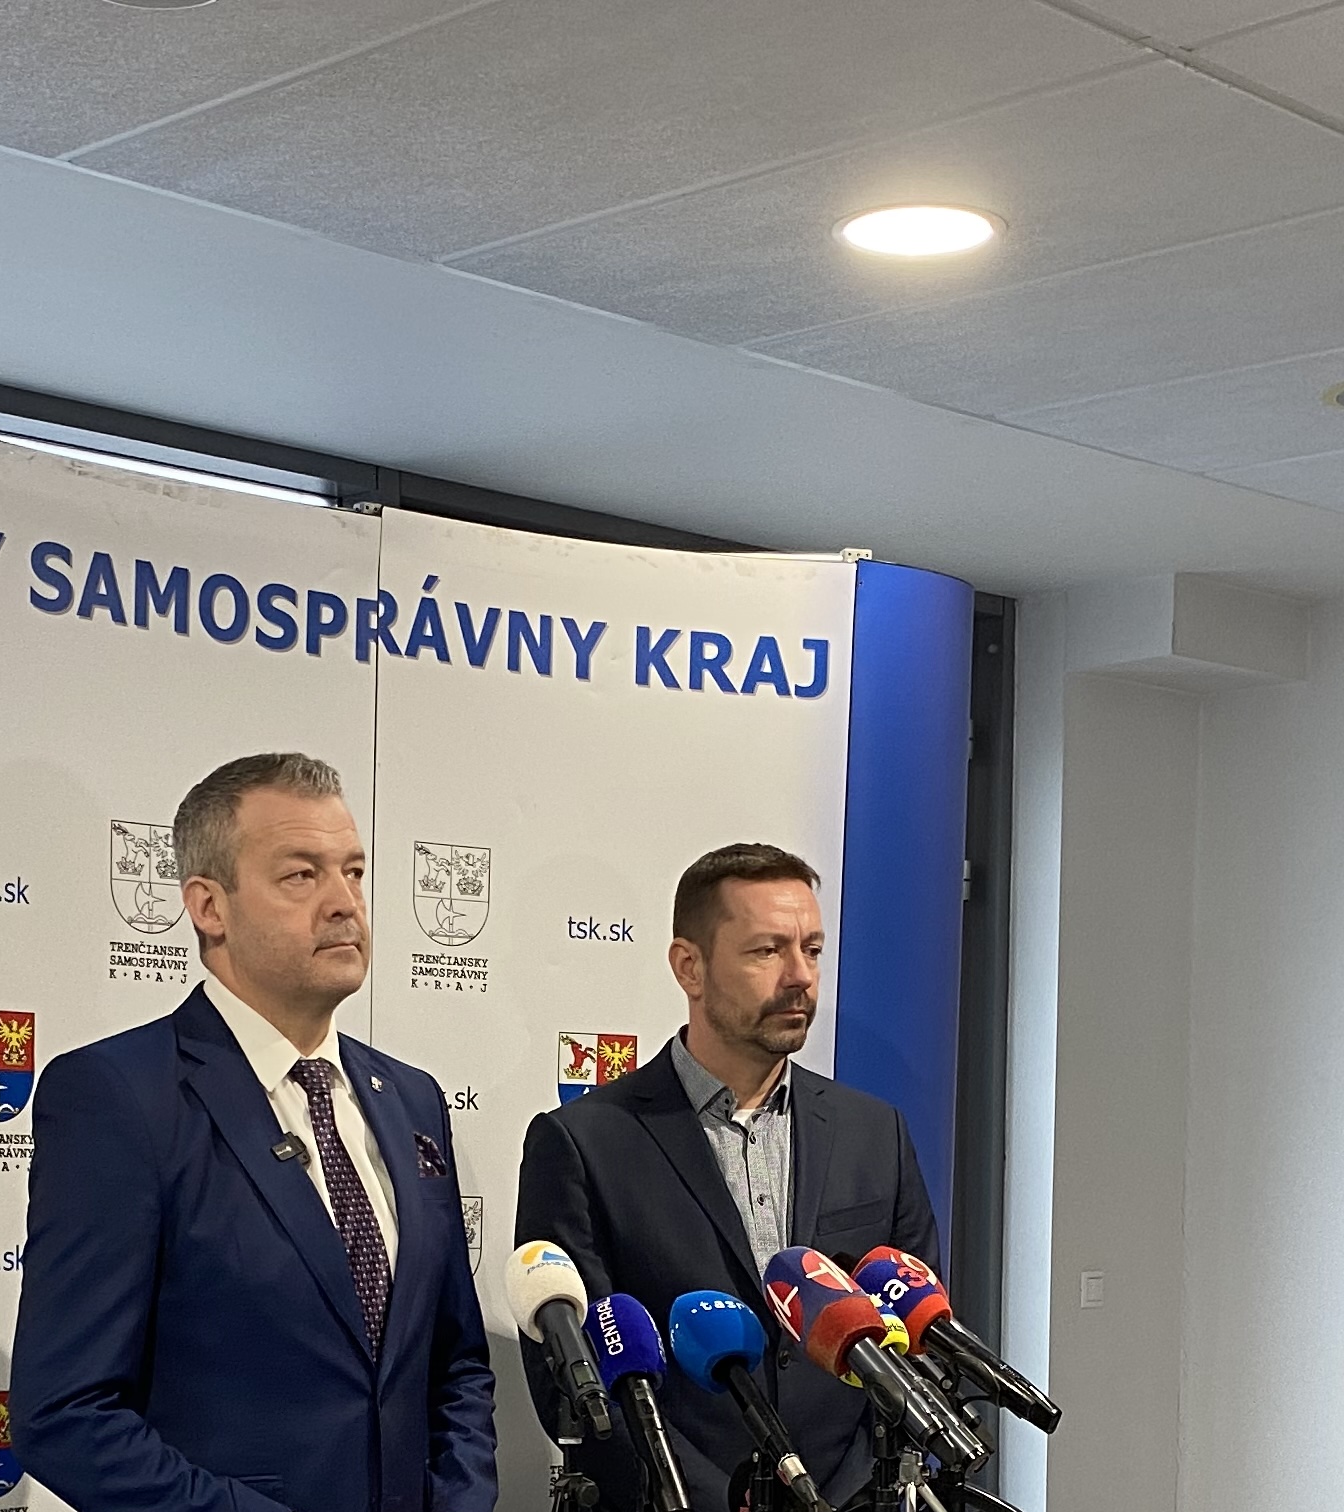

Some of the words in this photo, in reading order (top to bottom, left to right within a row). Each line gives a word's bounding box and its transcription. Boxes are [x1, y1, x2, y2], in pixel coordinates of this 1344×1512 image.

[29, 541, 607, 683] SAMOSPRÁVNY
[633, 625, 831, 701] KRAJ
[567, 916, 634, 942] tsk.sk
[110, 941, 188, 957] TRENČIANSKY
[110, 955, 188, 970] SAMOSPRÁVNY
[411, 953, 488, 968] TRENČIANSKY
[411, 966, 488, 980] SAMOSPRÁVNY
[597, 1297, 624, 1355] CENTRAL
